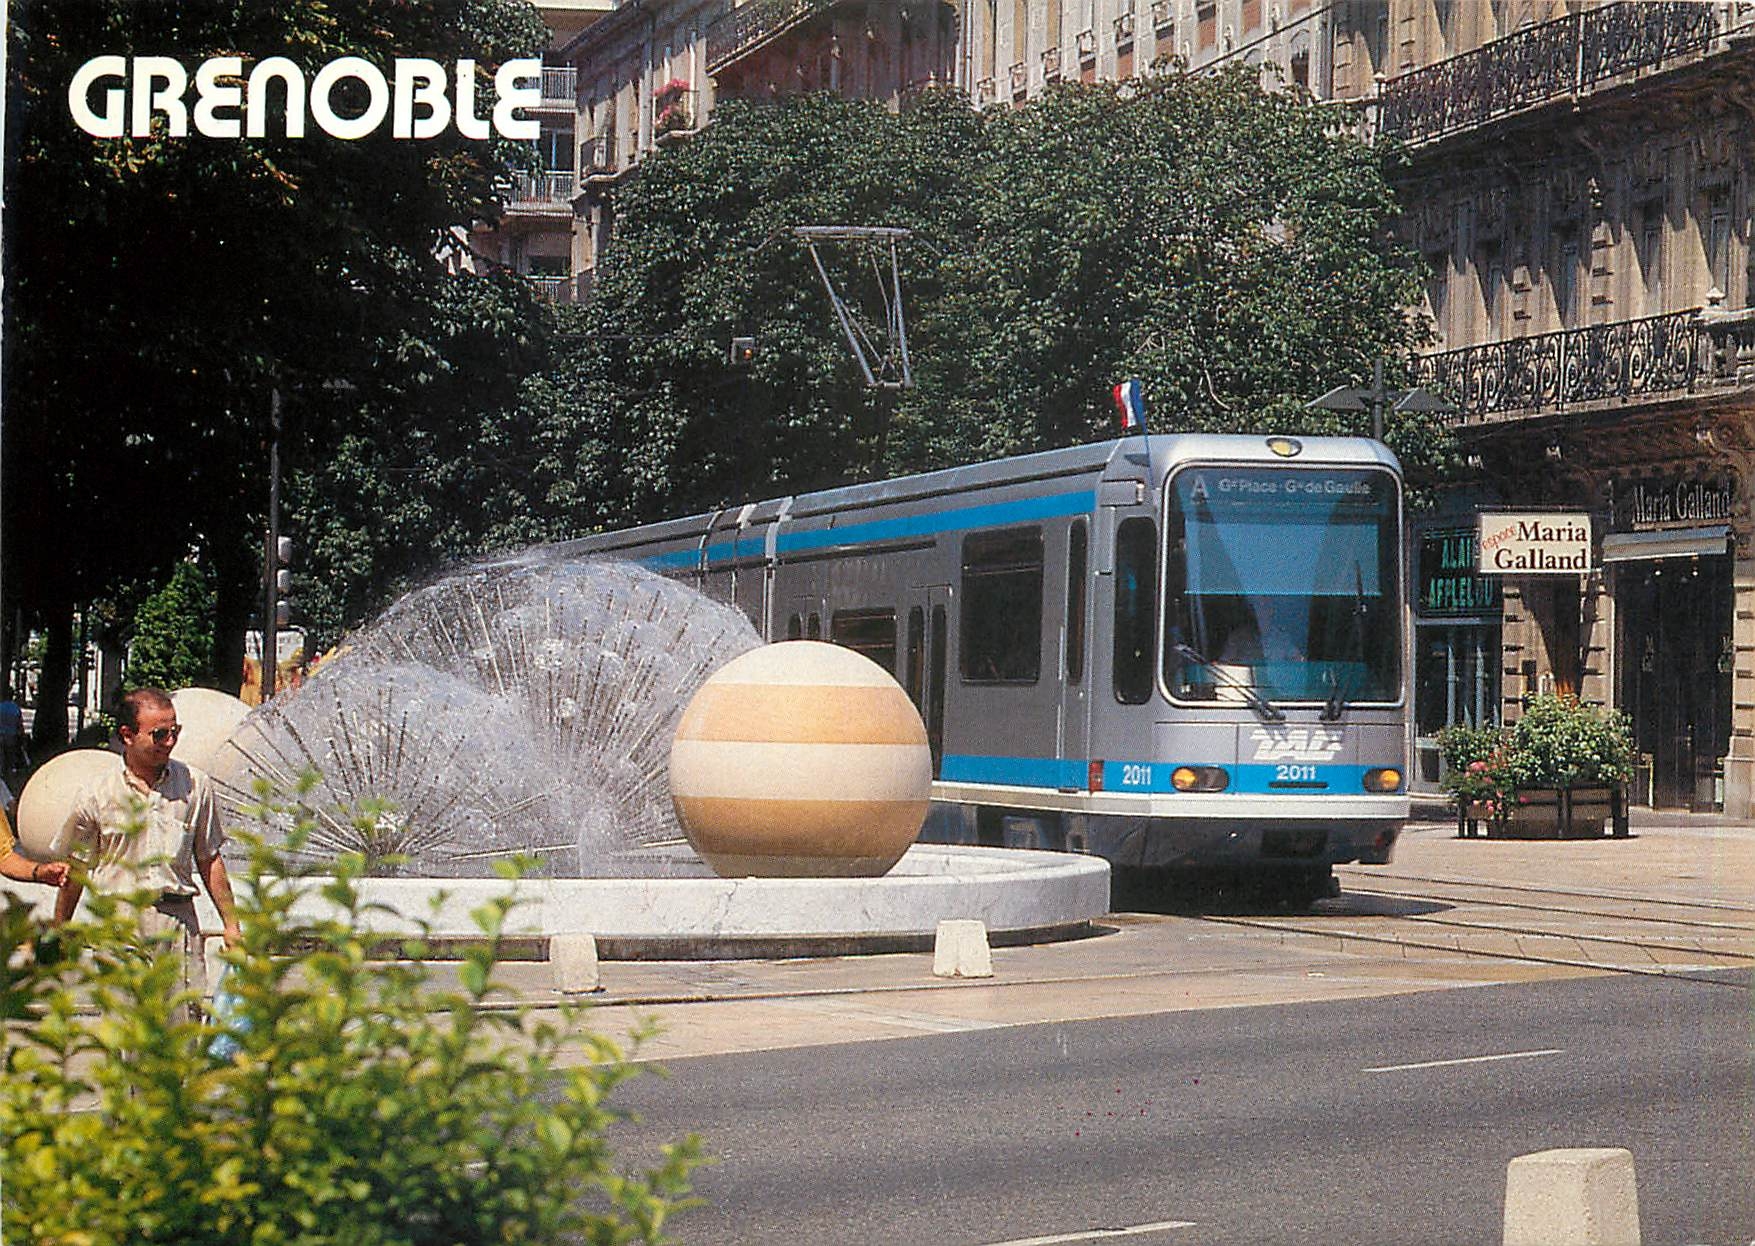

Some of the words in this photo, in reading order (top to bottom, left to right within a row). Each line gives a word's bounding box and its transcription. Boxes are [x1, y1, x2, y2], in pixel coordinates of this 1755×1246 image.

[1190, 476, 1209, 498] A
[1631, 486, 1671, 523] Maria
[1676, 481, 1730, 520] Galland
[1516, 521, 1588, 541] Maria
[1494, 548, 1587, 569] Galland
[1122, 764, 1152, 785] 2011
[1275, 764, 1316, 780] 2011
